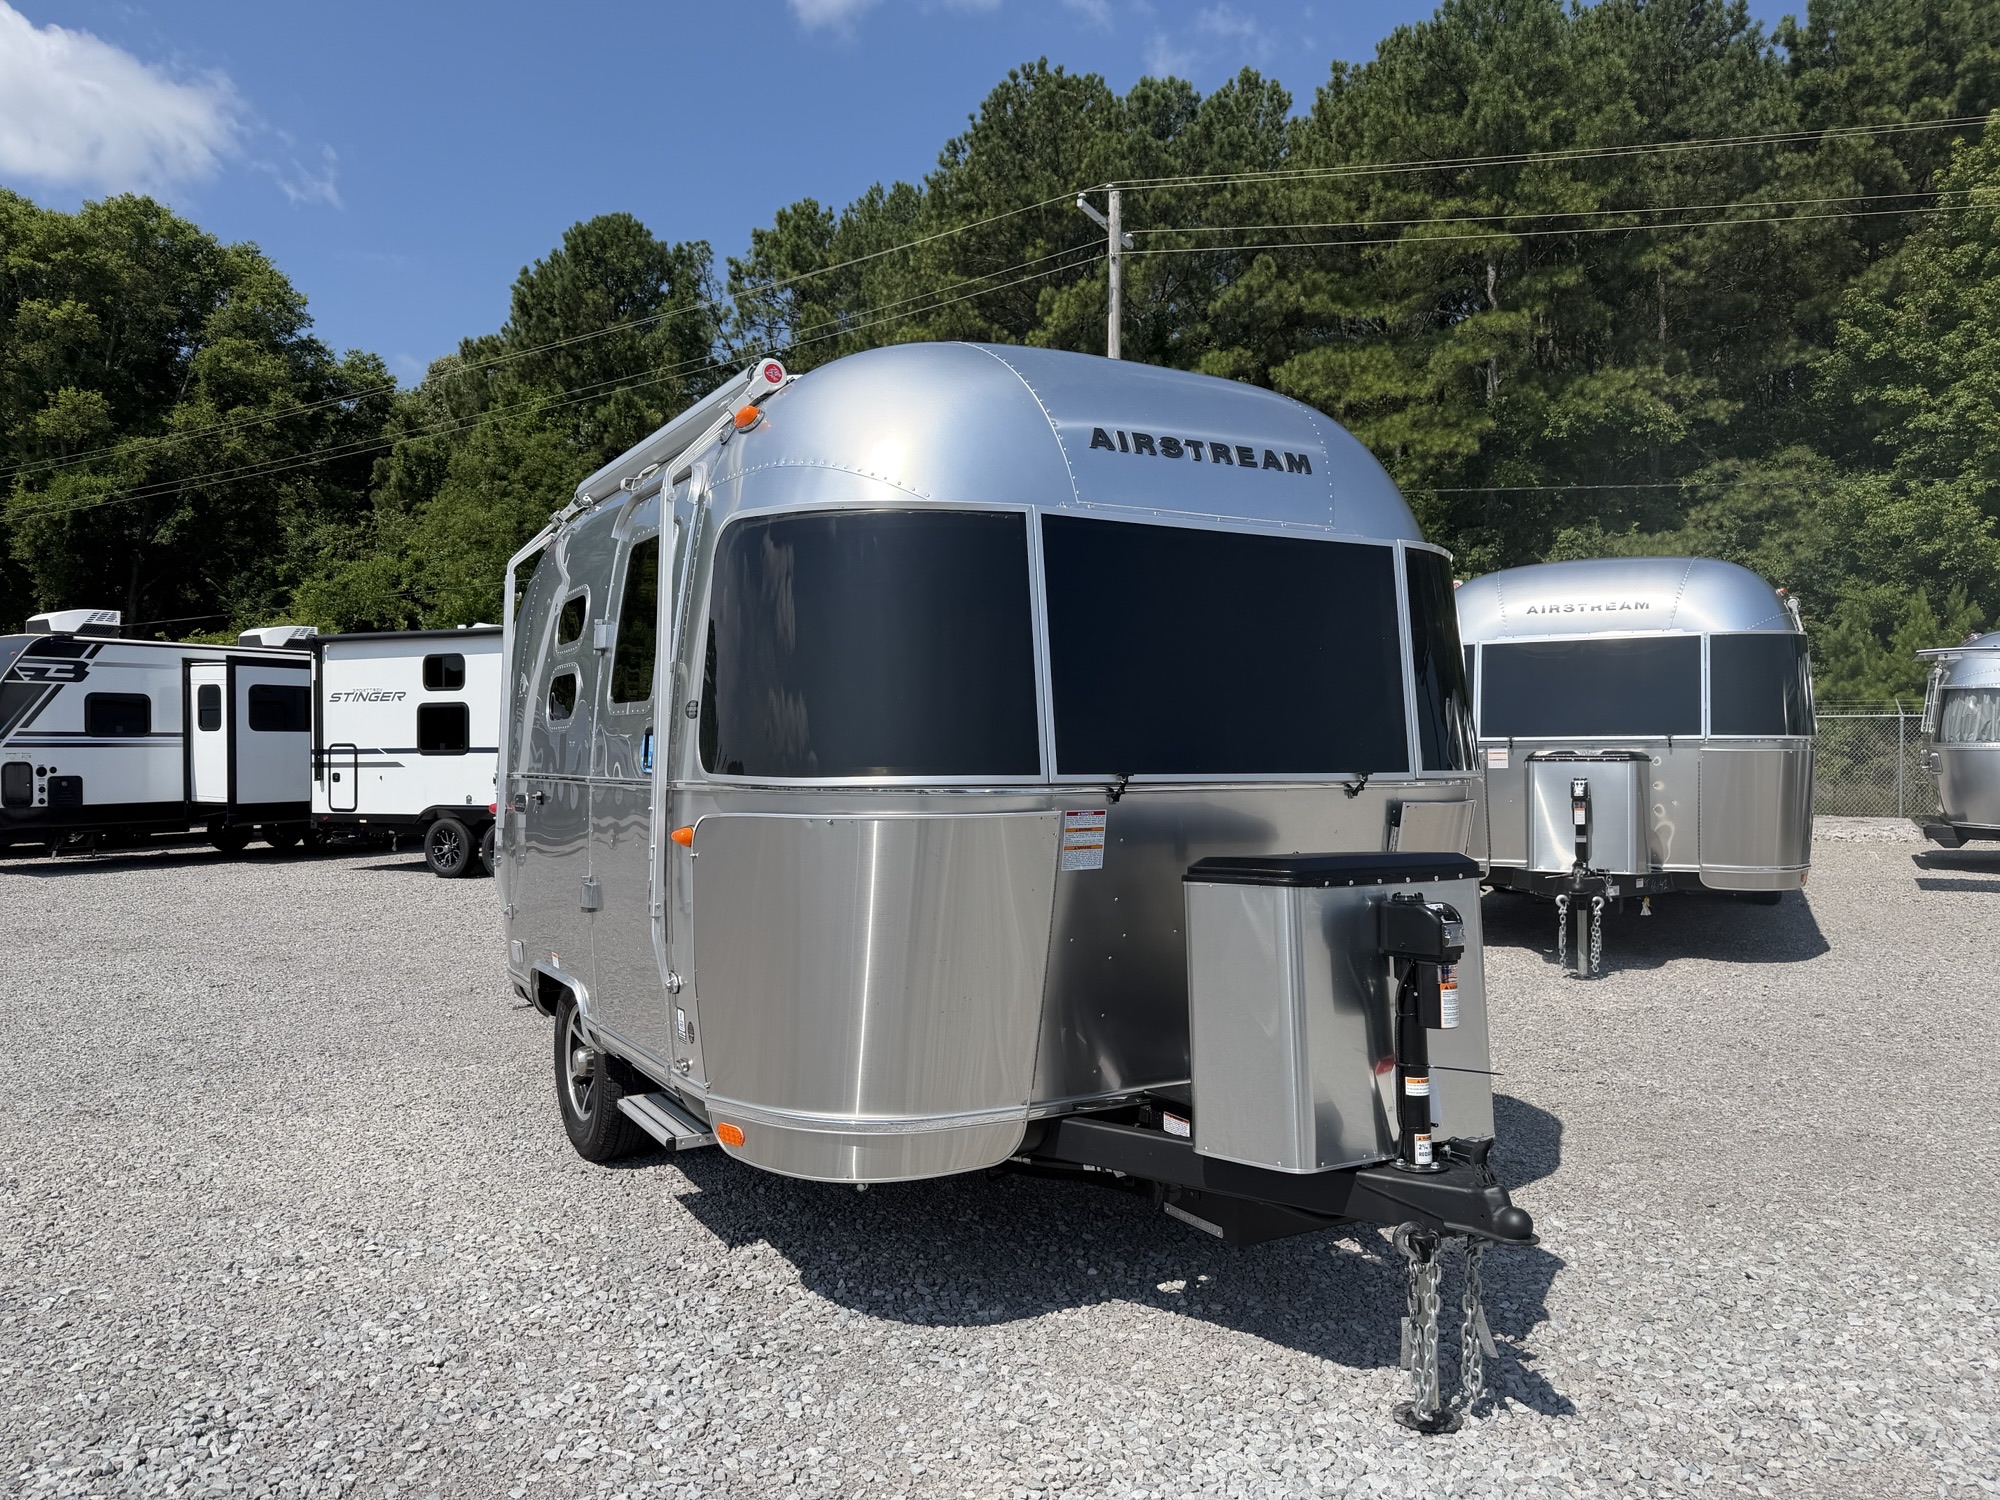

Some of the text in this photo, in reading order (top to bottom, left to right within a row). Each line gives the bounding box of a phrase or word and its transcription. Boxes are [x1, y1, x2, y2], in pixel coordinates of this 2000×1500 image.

[1089, 427, 1312, 475] AIRSTREAM
[1526, 601, 1650, 615] AIRSTREAM
[329, 691, 407, 702] STINGER
